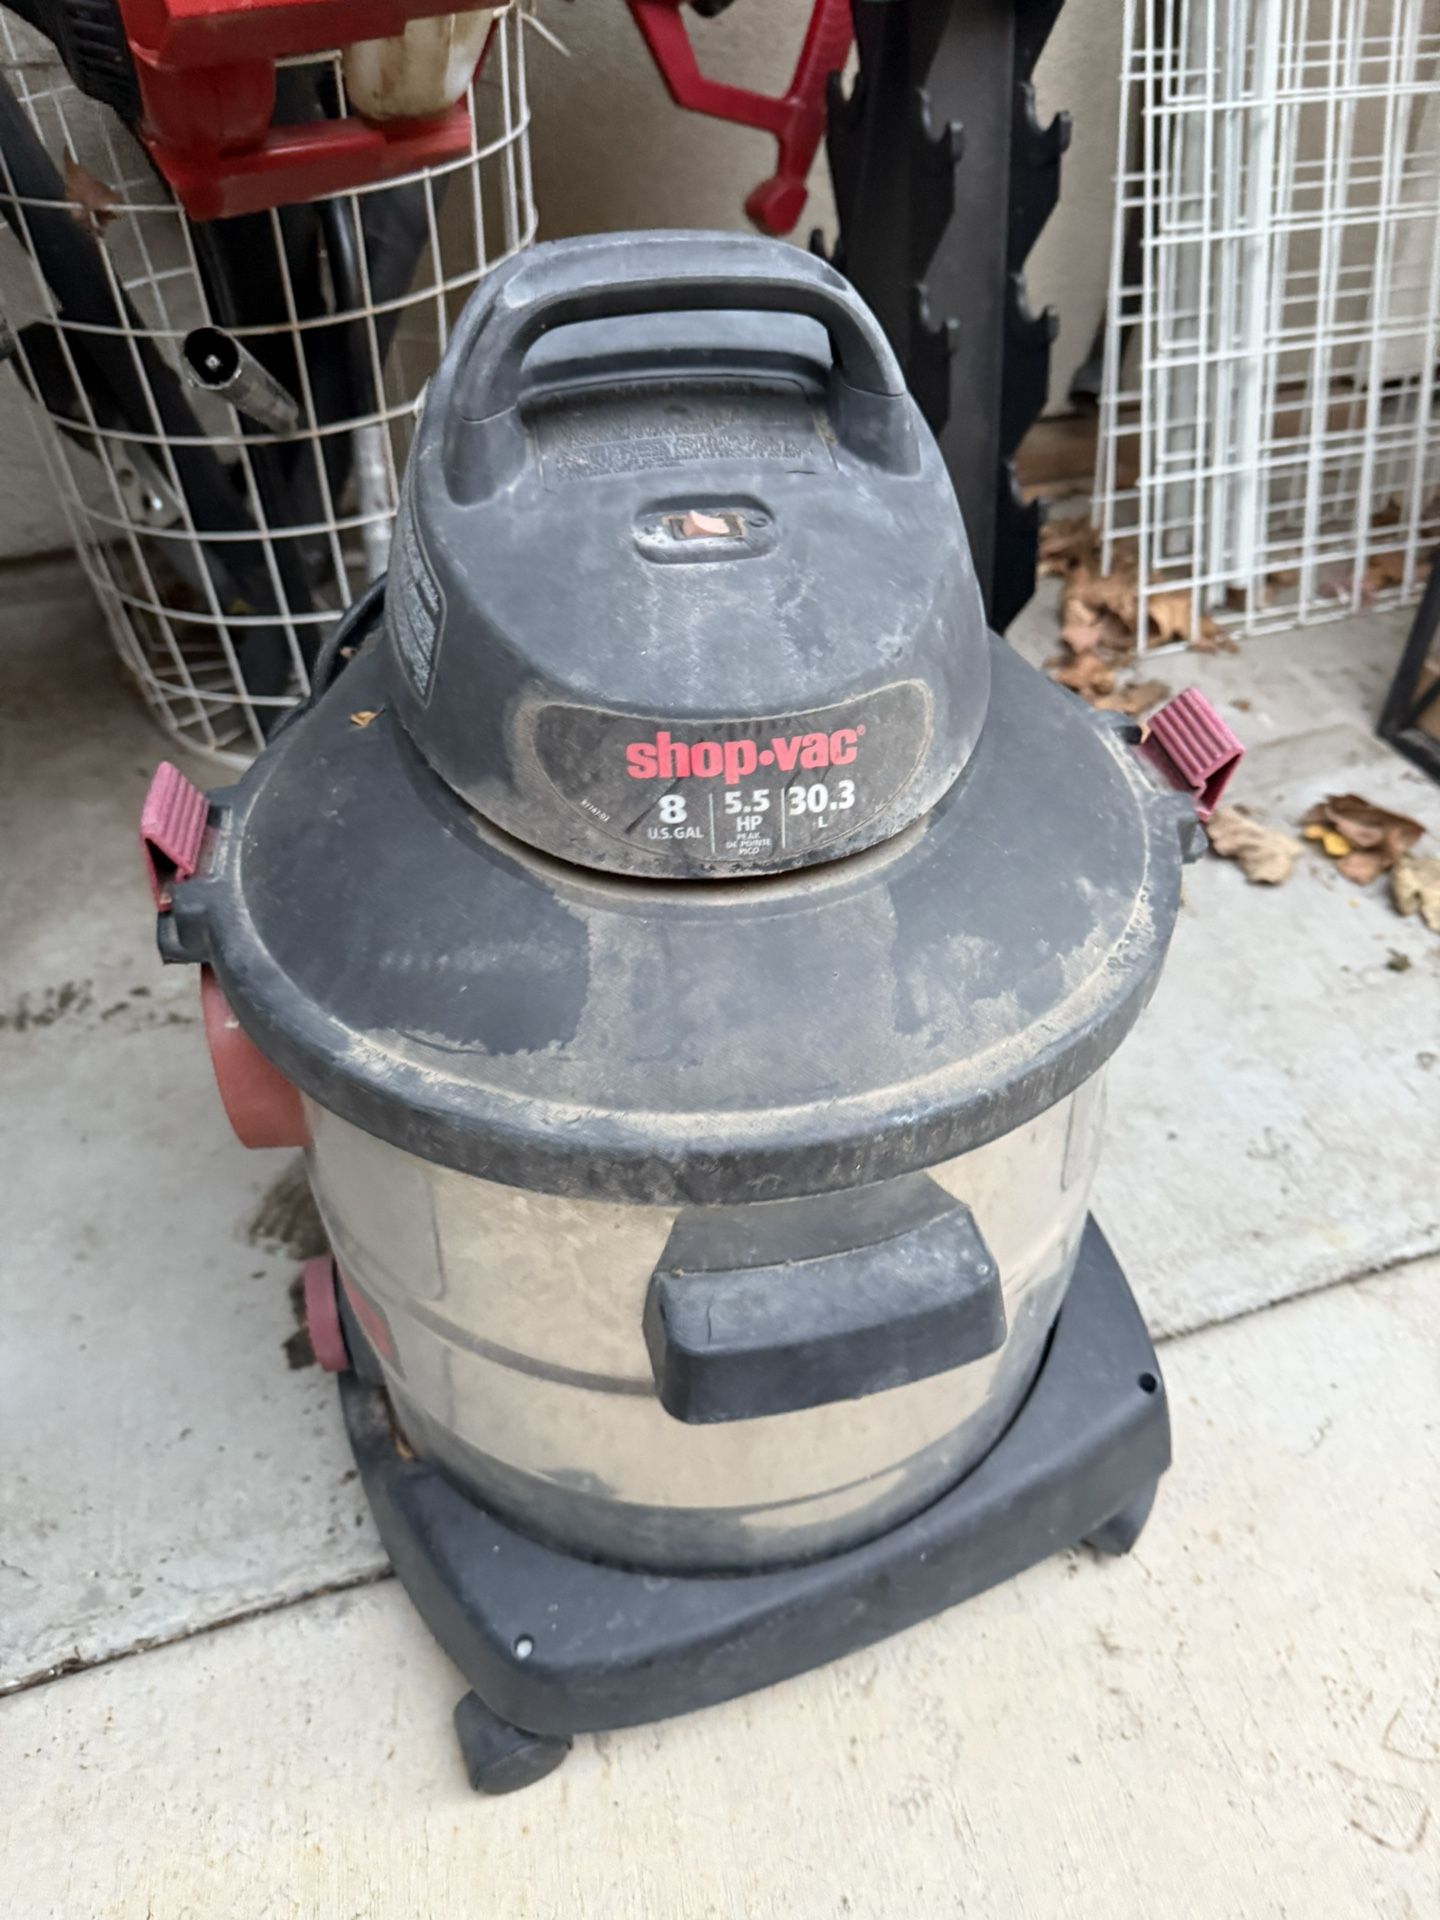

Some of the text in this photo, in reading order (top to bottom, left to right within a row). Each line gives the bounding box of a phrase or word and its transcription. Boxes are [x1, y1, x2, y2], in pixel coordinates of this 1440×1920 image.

[725, 789, 770, 814] 5.5
[788, 780, 856, 816] 30.3
[658, 794, 688, 825] 8
[674, 826, 705, 839] GAL
[736, 815, 763, 832] HP
[818, 816, 829, 829] L
